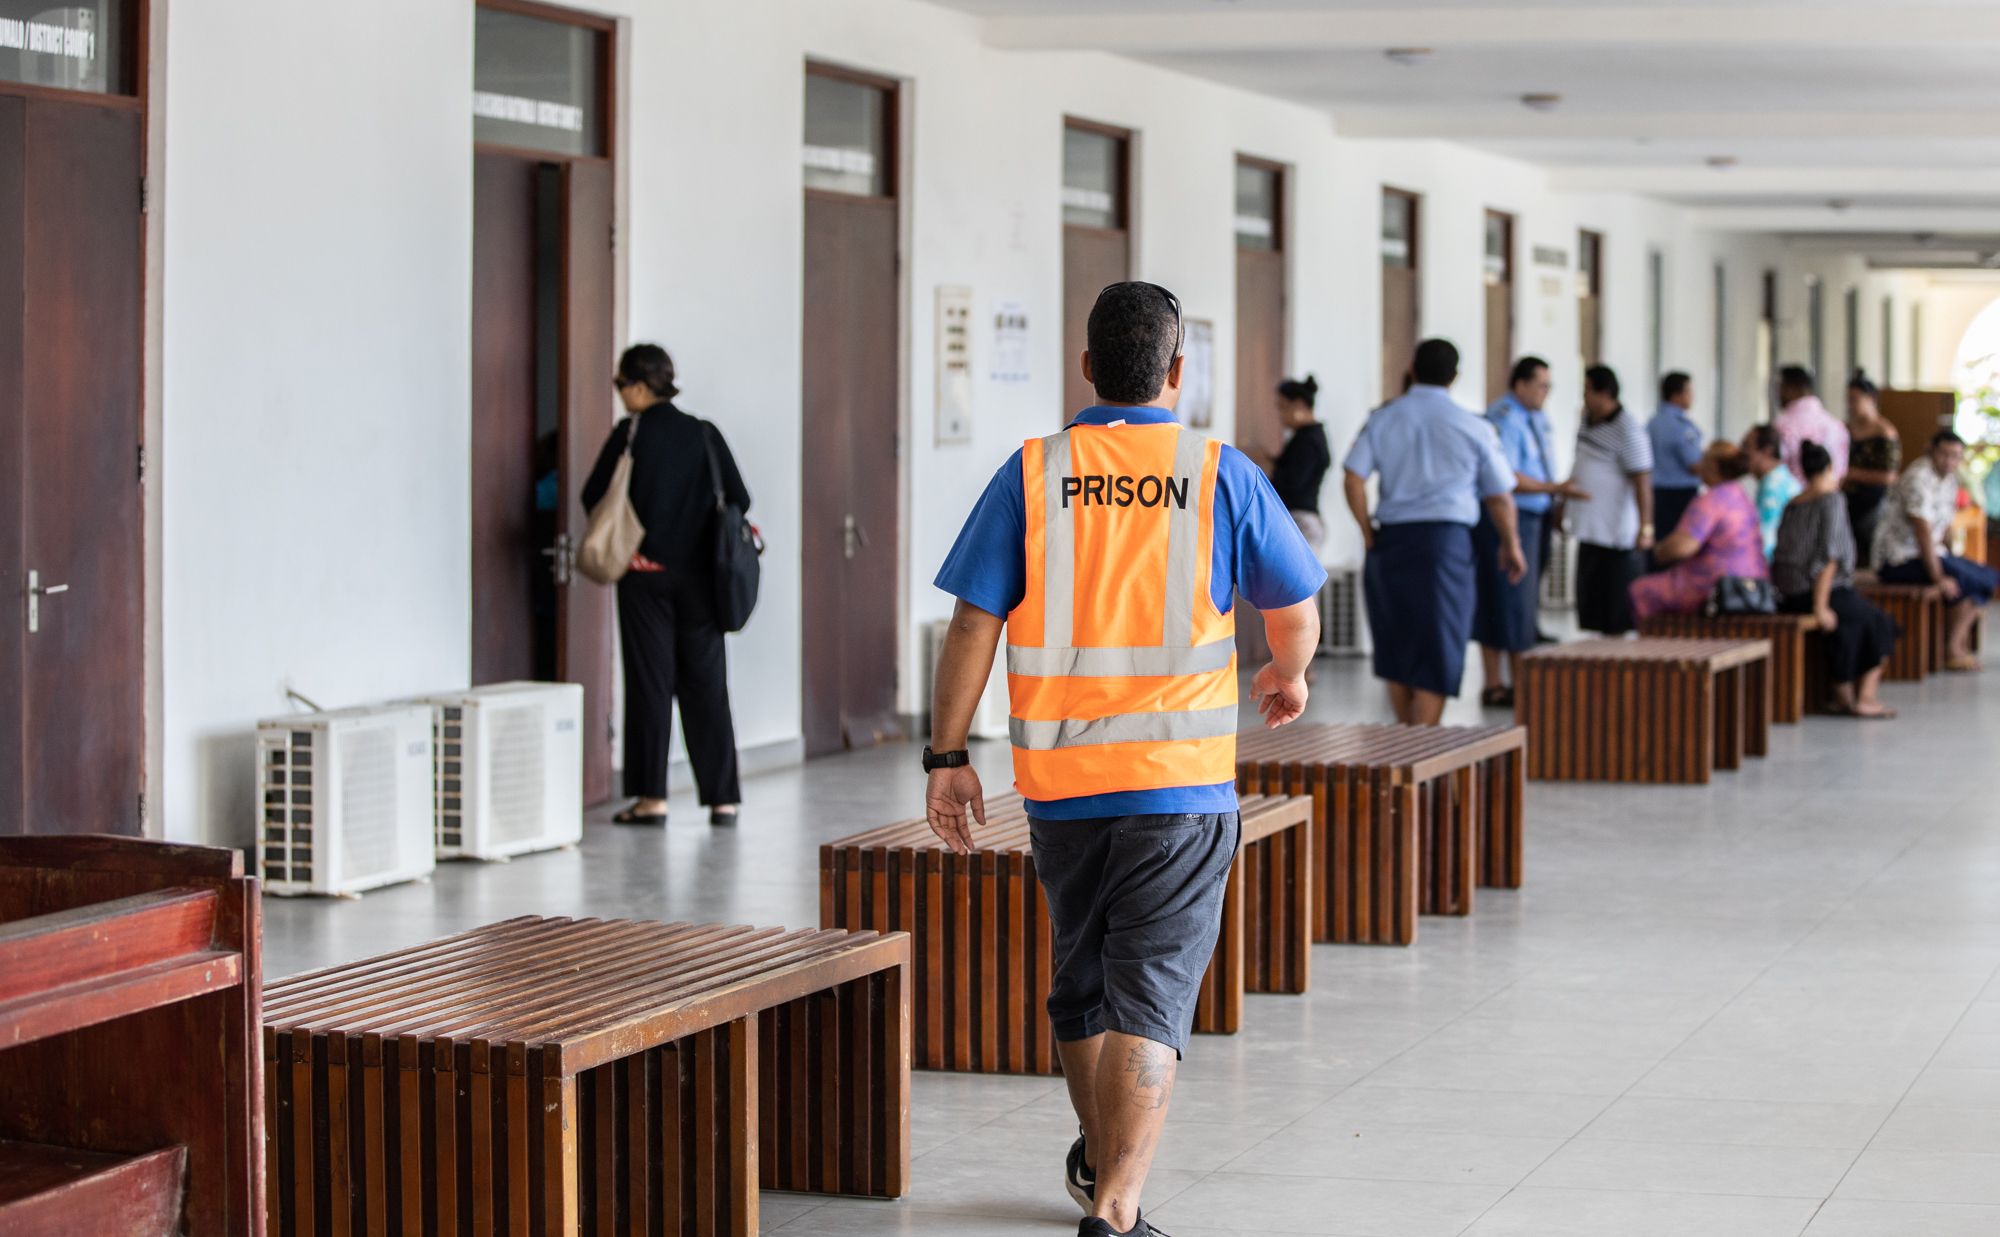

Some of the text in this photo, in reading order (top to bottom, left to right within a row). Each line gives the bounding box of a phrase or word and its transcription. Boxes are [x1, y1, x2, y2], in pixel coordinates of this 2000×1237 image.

[29, 21, 63, 55] DISTRICT
[64, 26, 88, 58] COURT
[89, 31, 94, 60] 1
[1062, 474, 1189, 509] PRISON
